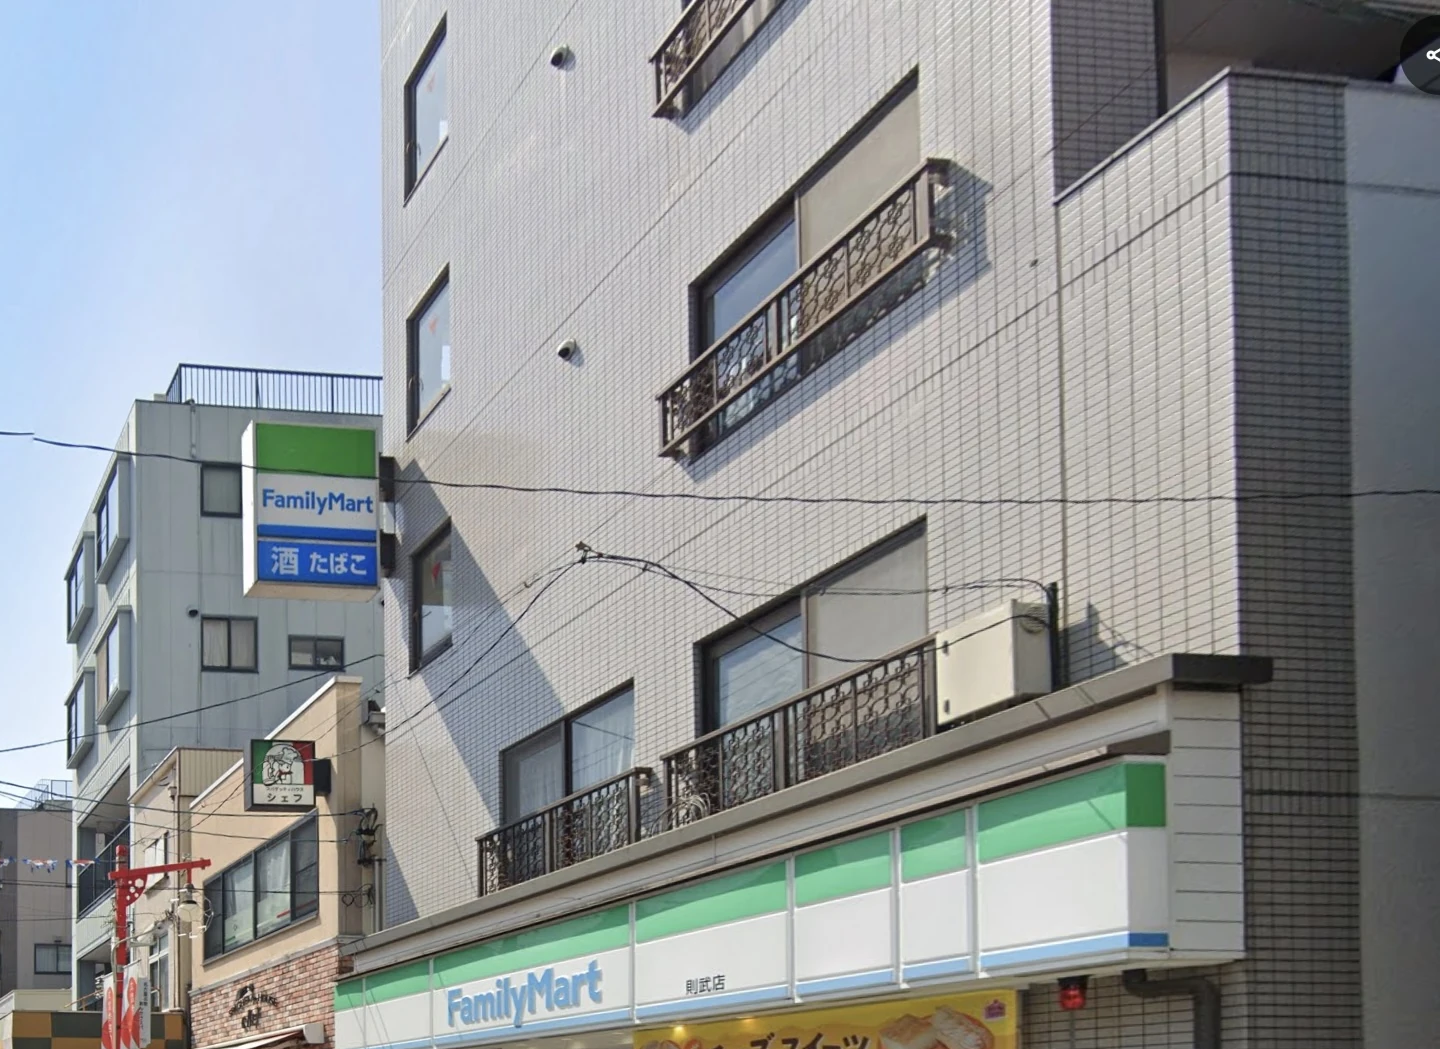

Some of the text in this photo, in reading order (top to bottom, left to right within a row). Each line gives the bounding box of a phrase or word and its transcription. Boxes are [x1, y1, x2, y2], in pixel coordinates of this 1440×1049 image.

[262, 488, 373, 515] FamilyMart
[271, 546, 367, 575] 酒 たばこ
[267, 793, 303, 803] シェフ
[447, 959, 603, 1028] FamilyMart
[685, 974, 726, 995] 則武店
